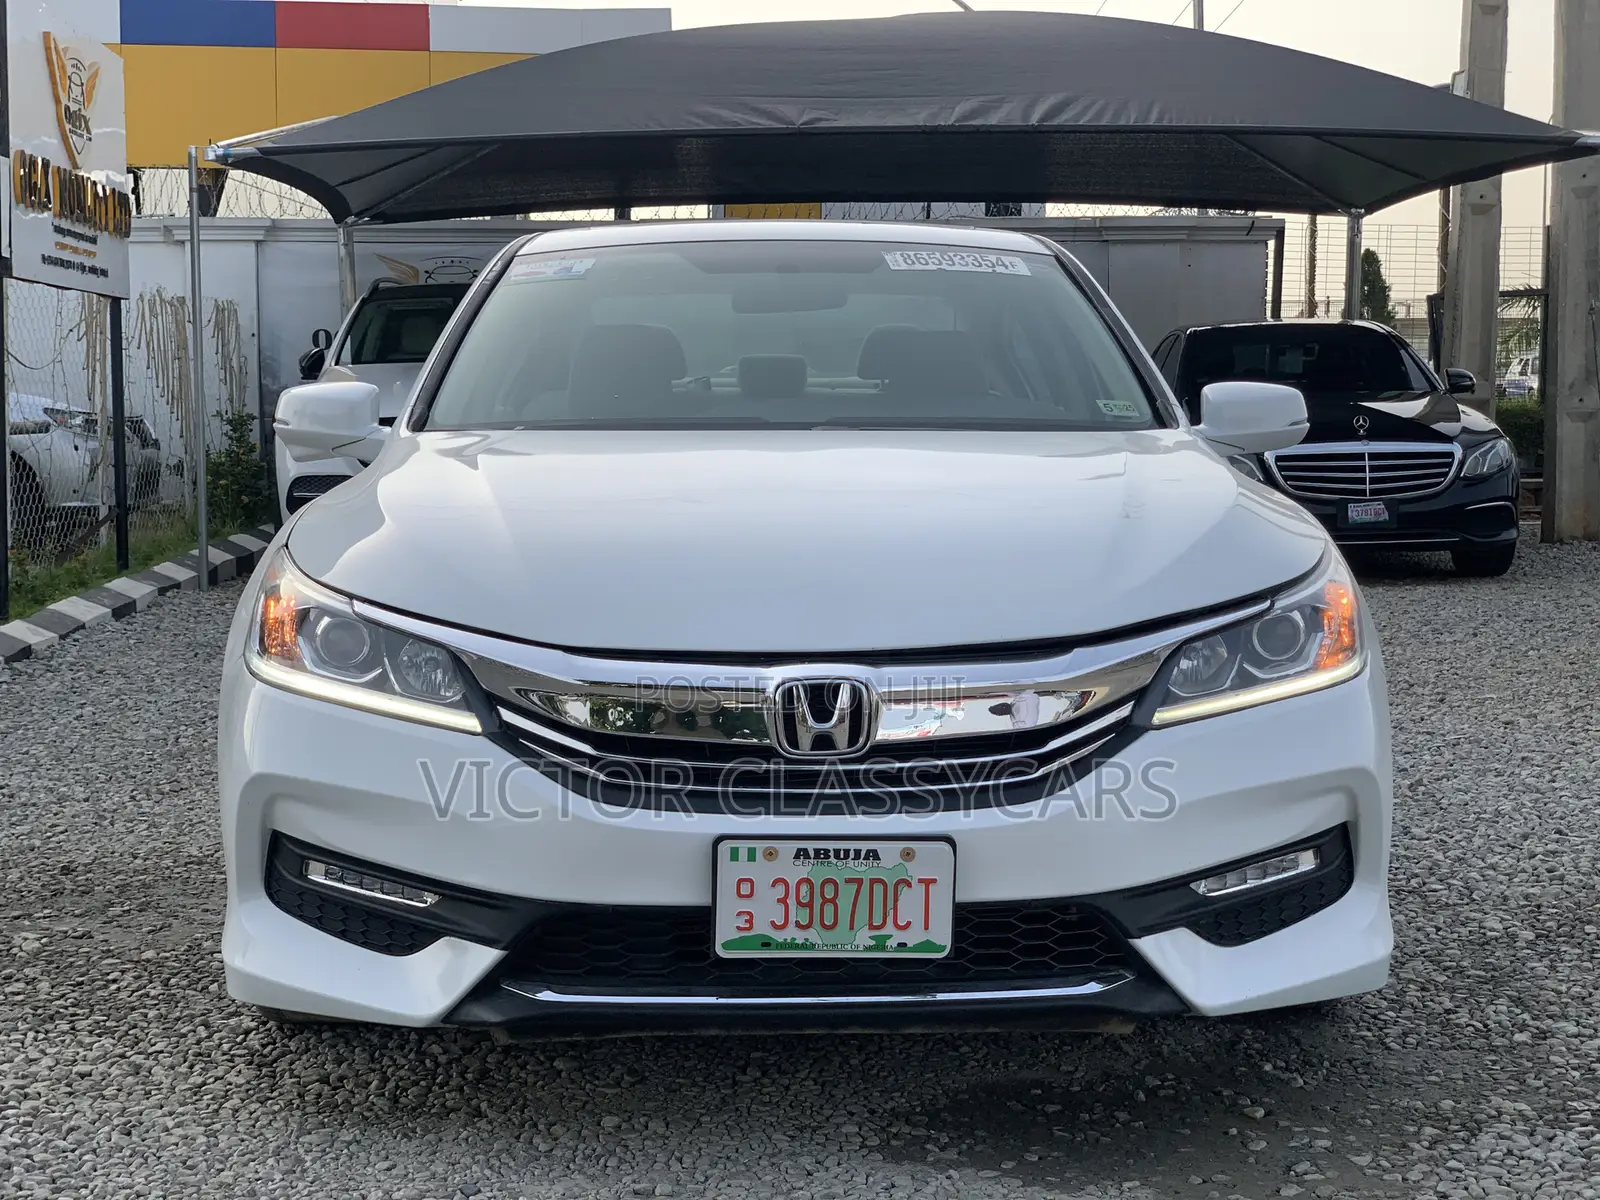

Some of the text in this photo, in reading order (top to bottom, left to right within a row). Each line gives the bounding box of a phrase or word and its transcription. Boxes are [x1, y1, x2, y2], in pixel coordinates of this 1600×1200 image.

[792, 847, 882, 861] ABUJA
[792, 860, 882, 868] CENTRE OF UNITY
[769, 877, 938, 931] 3987DCT
[863, 943, 894, 951] NIGERIA
